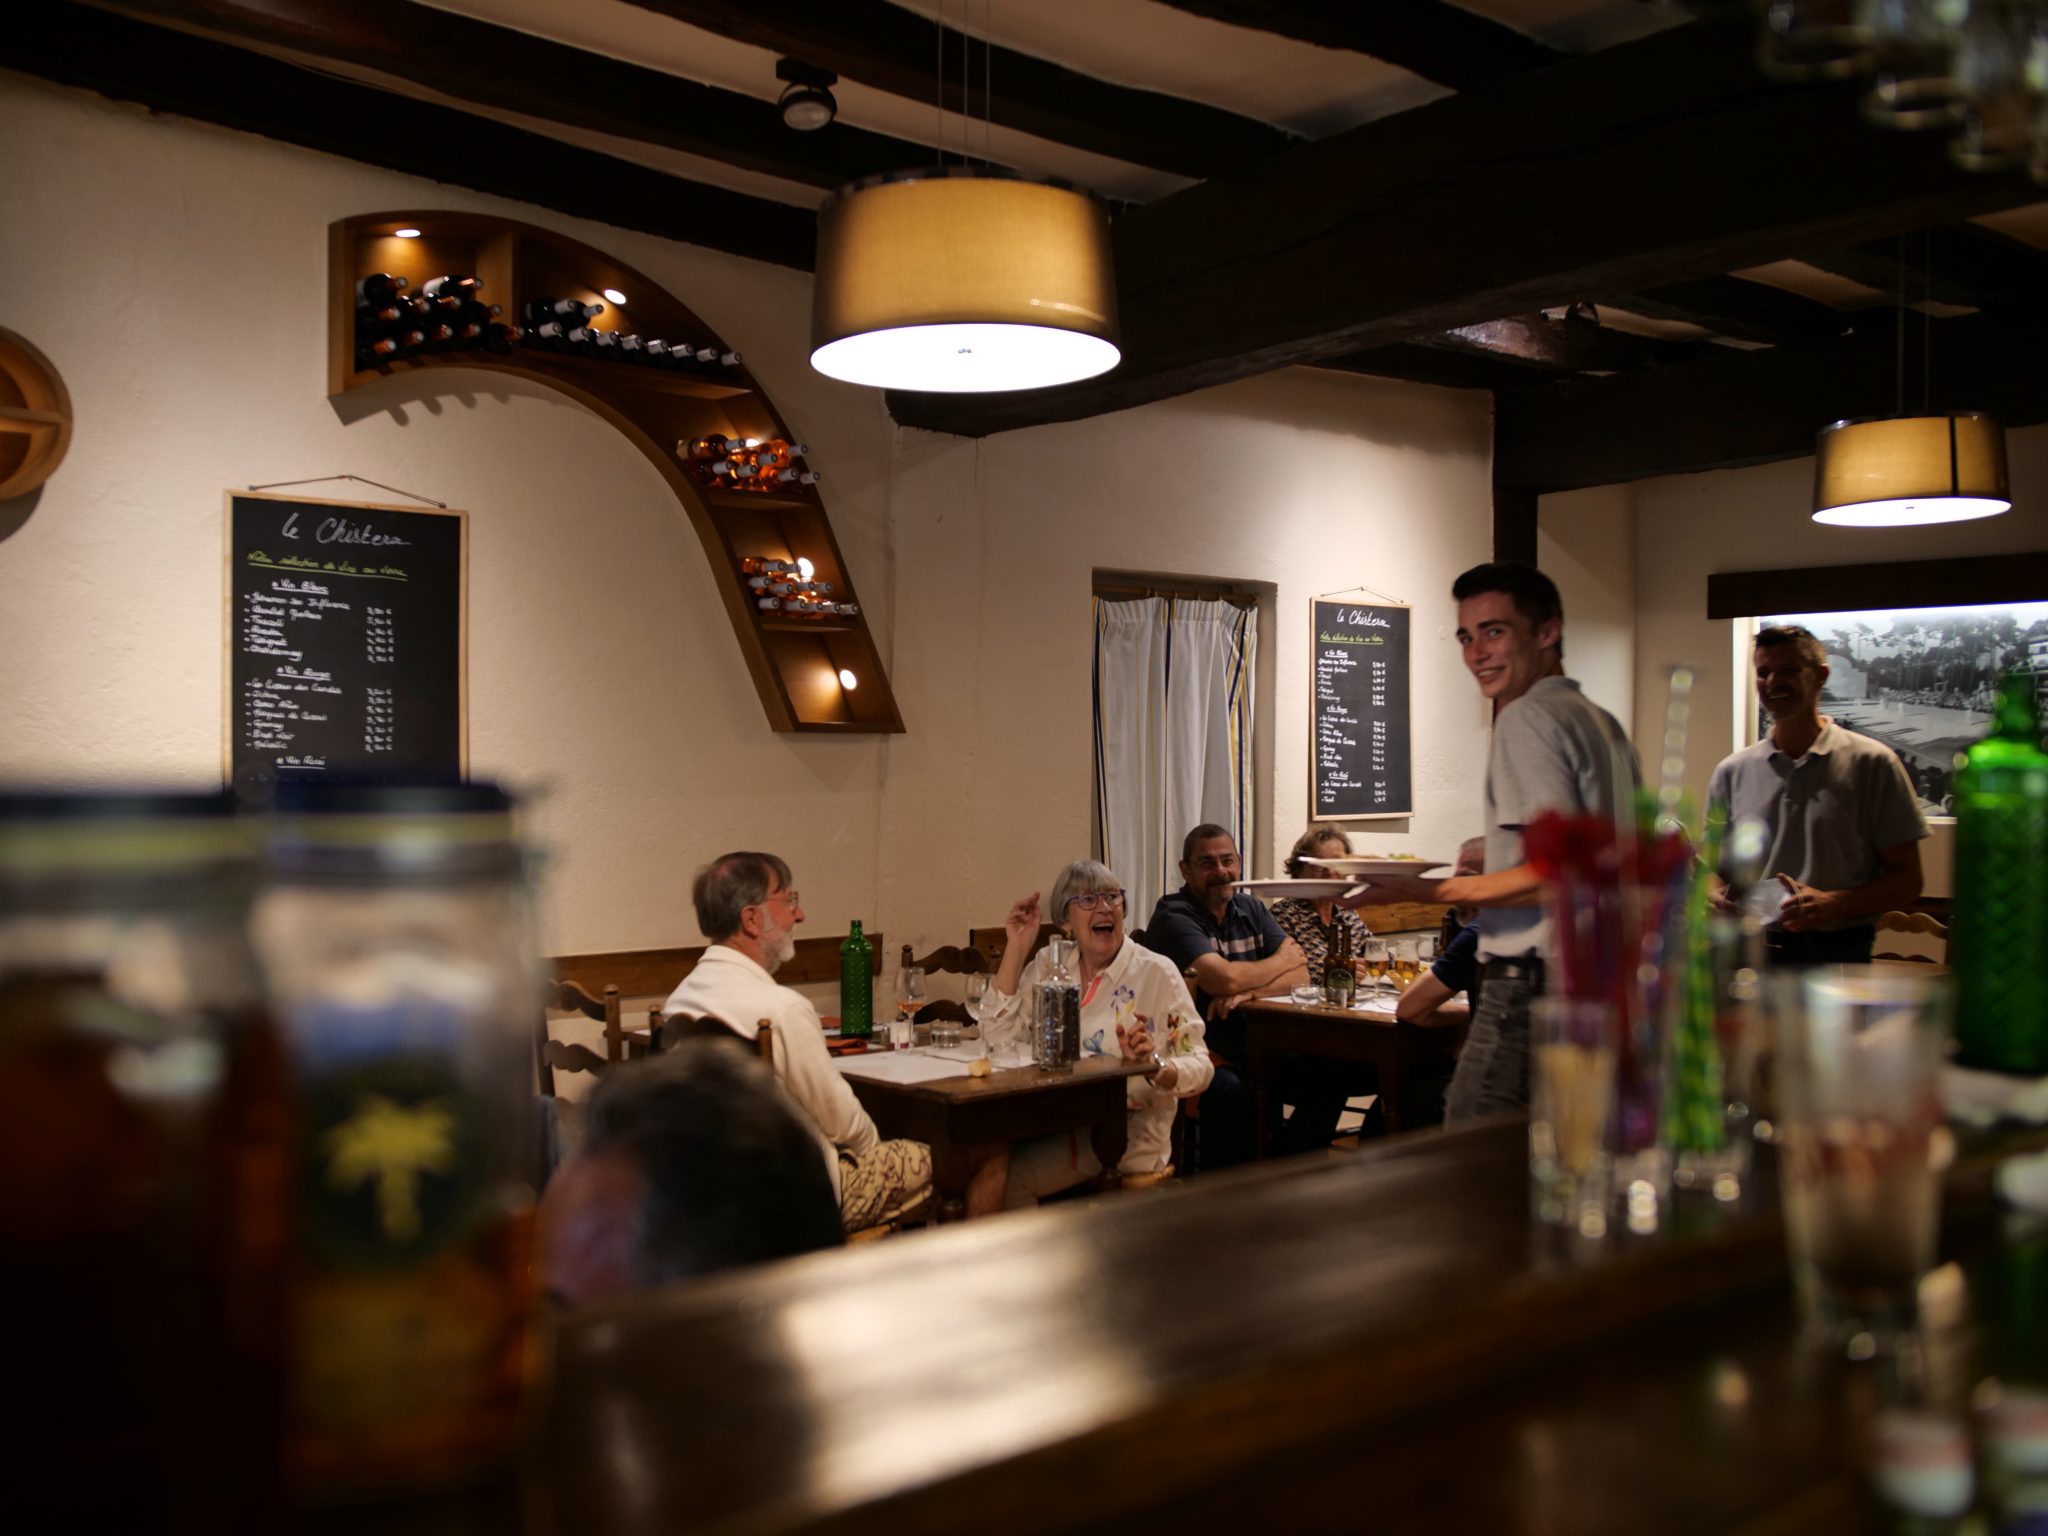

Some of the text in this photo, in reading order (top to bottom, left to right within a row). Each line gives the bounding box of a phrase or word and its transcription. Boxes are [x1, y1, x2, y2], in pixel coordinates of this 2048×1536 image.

[281, 512, 412, 546] Le Chistera
[1348, 609, 1391, 628] Chistera
